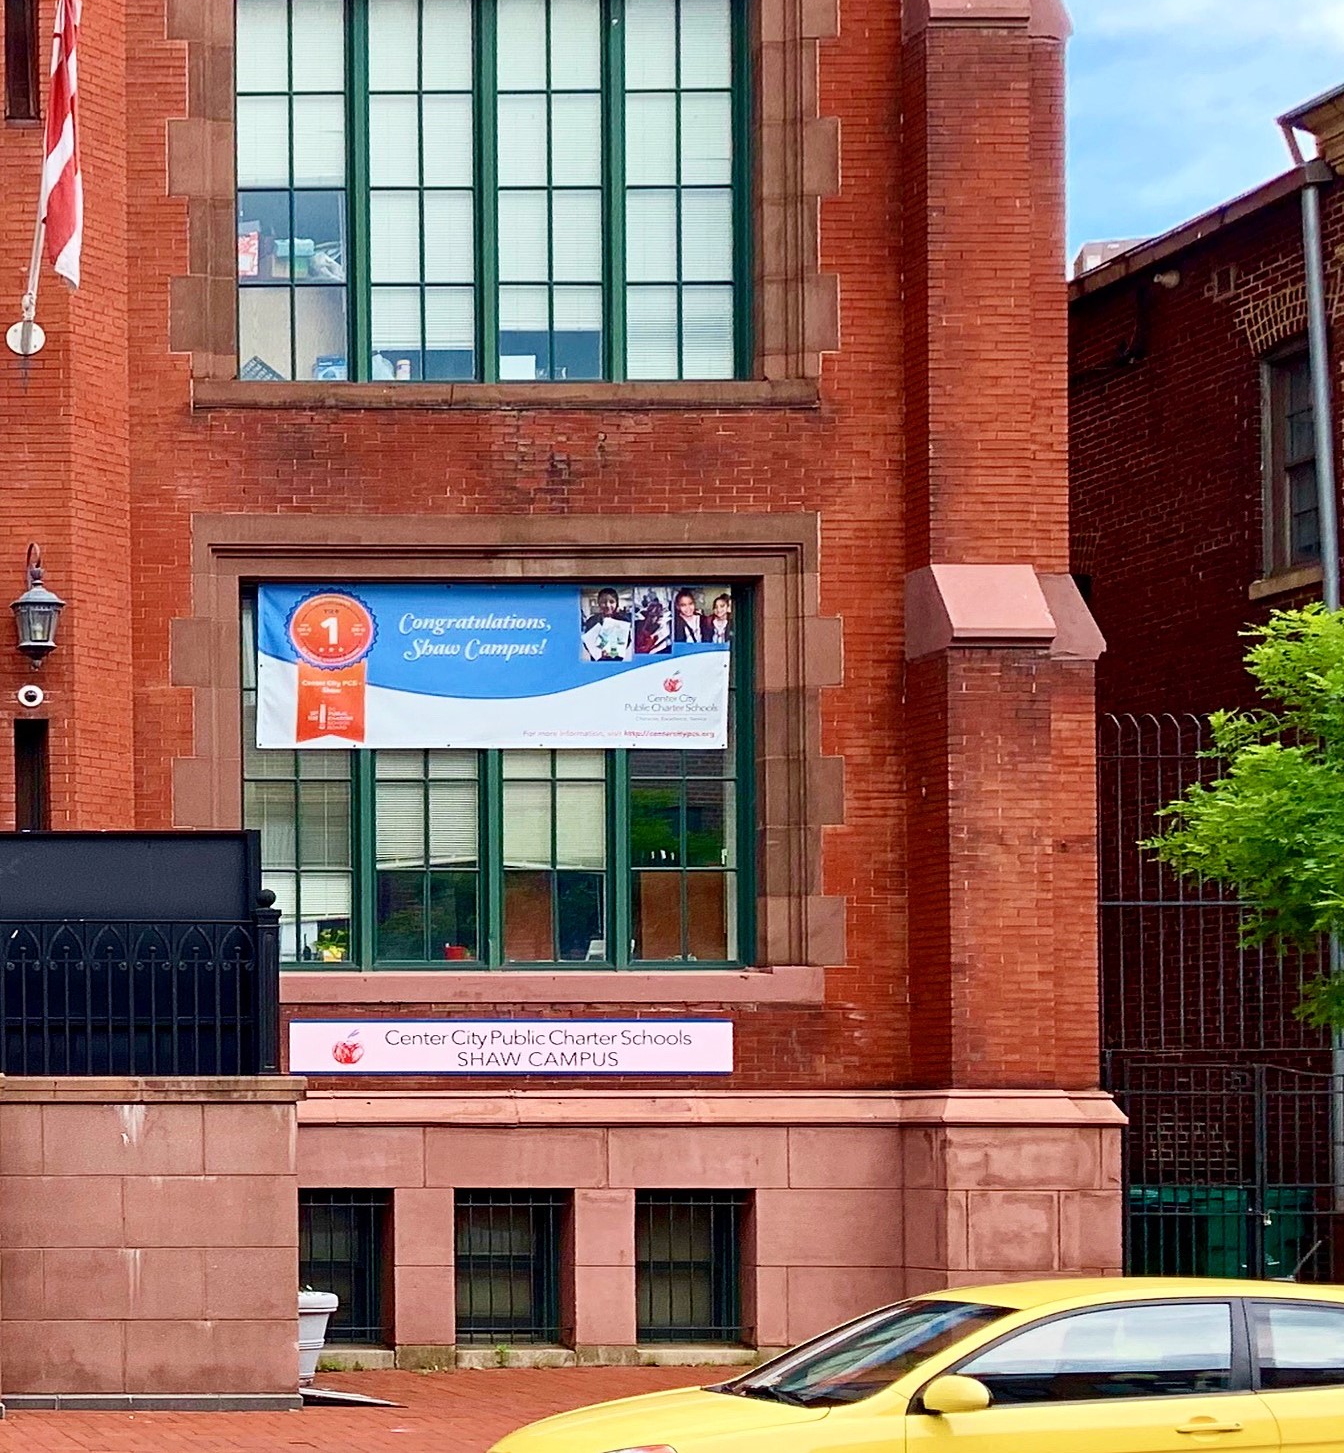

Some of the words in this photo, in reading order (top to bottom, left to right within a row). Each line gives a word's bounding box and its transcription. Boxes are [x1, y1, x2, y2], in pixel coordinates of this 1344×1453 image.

[320, 617, 338, 645] 1
[398, 612, 552, 636] Congratulations,
[403, 638, 461, 661] Shaw
[464, 638, 548, 662] Campus!
[624, 703, 650, 712] Public
[651, 703, 684, 712] Charter
[685, 703, 718, 712] Schools
[647, 694, 677, 703] Center
[679, 694, 697, 704] City
[385, 1030, 448, 1046] Center
[451, 1030, 487, 1049] City
[490, 1030, 545, 1046] Public
[549, 1029, 617, 1046] Charter
[621, 1029, 692, 1046] Schools
[457, 1051, 521, 1067] SHAW
[528, 1051, 618, 1067] CAMPUS
